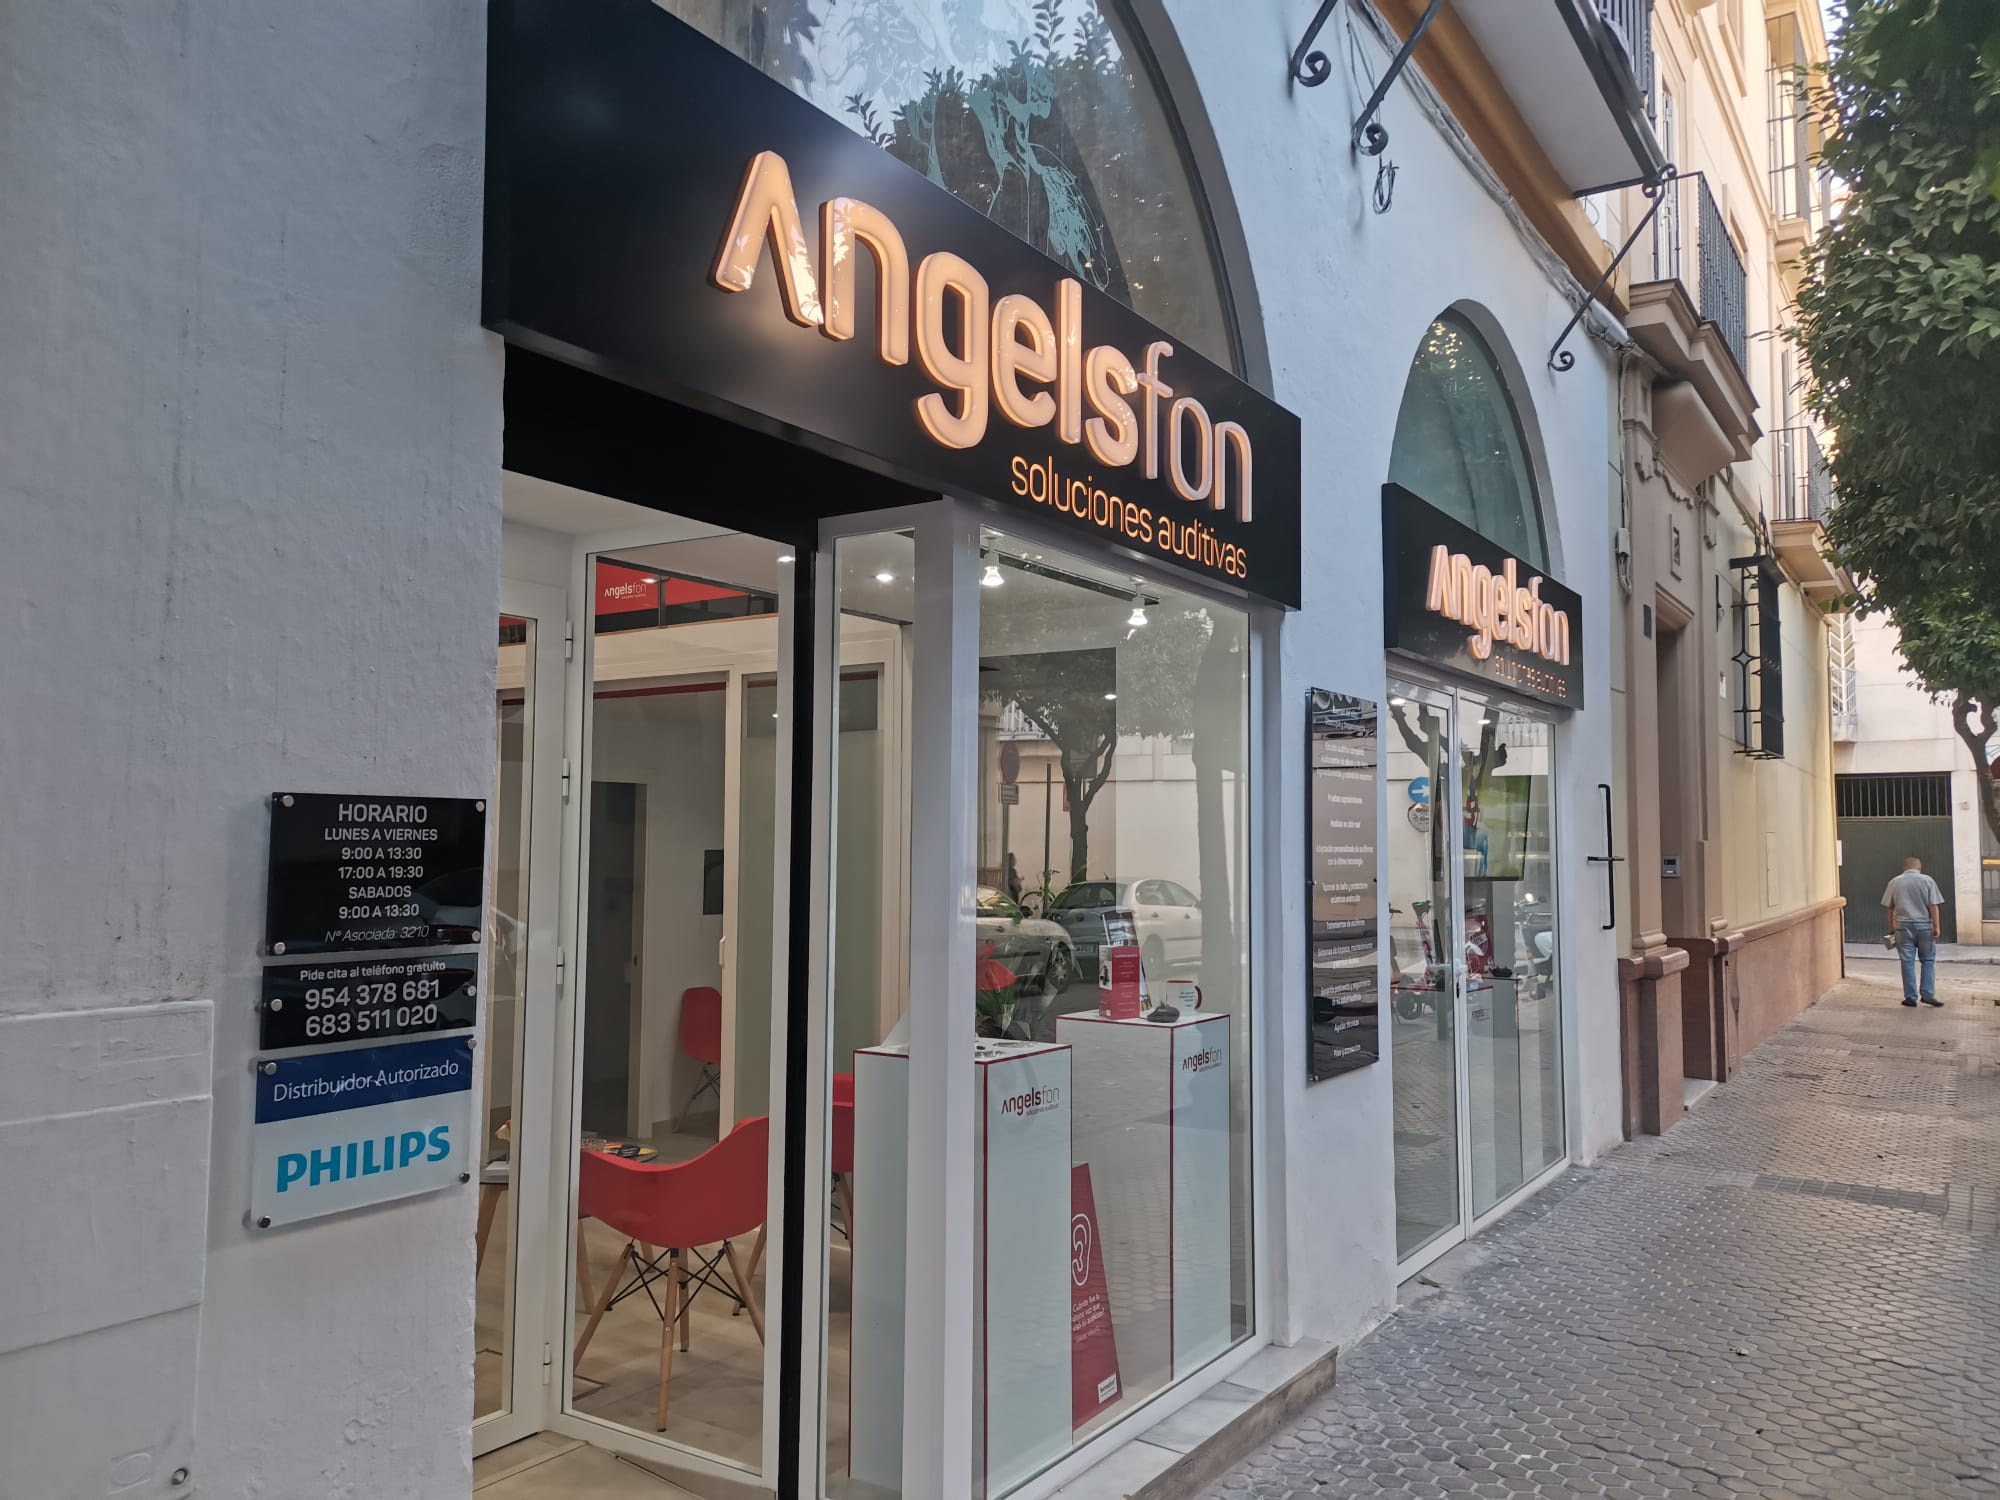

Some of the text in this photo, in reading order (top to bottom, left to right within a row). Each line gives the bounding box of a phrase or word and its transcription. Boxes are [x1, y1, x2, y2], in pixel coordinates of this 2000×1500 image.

[1011, 455, 1248, 579] soluciones auditivas
[338, 803, 428, 823] HORARIO
[324, 828, 438, 841] LUNES A VIERNES
[341, 847, 422, 860] 9:00 A 13:30
[338, 865, 424, 879] 17:00 A 19:30
[348, 885, 412, 899] SABADOS
[338, 904, 420, 919] 9:00 A 13:30
[400, 925, 430, 939] 3210
[300, 959, 446, 981] Pide cita al teléfono gratuito
[305, 979, 440, 1011] 954 378 681
[305, 1003, 438, 1037] 683 511 020
[274, 1059, 459, 1102] Distribuidor Autorizado
[276, 1125, 450, 1193] PHILIPS
